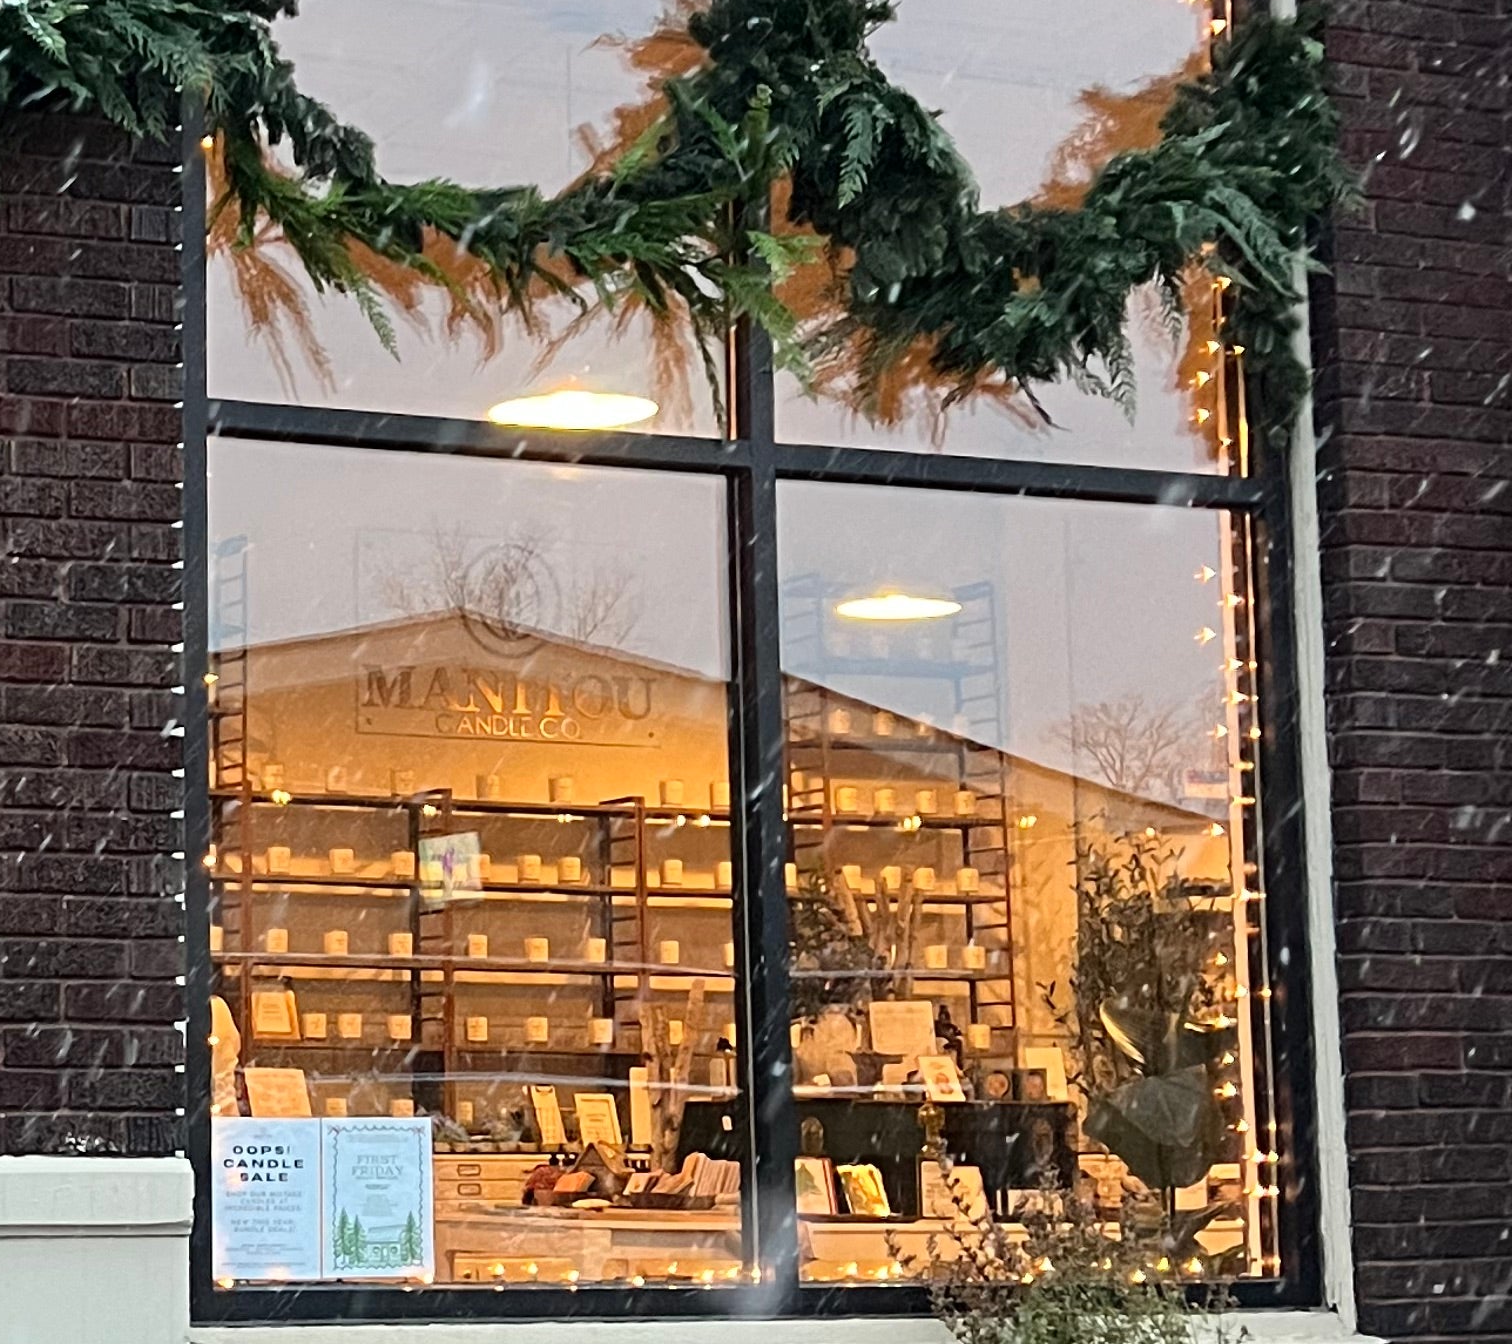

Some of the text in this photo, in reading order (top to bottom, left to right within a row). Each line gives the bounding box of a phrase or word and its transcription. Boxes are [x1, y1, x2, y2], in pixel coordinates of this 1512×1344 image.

[361, 664, 657, 720] MANITOU
[436, 713, 581, 739] CANDLE CO
[223, 1158, 304, 1168] CANDLE
[357, 1155, 398, 1165] FIRST
[352, 1165, 404, 1176] FRIDAY
[240, 1172, 288, 1182] SALE
